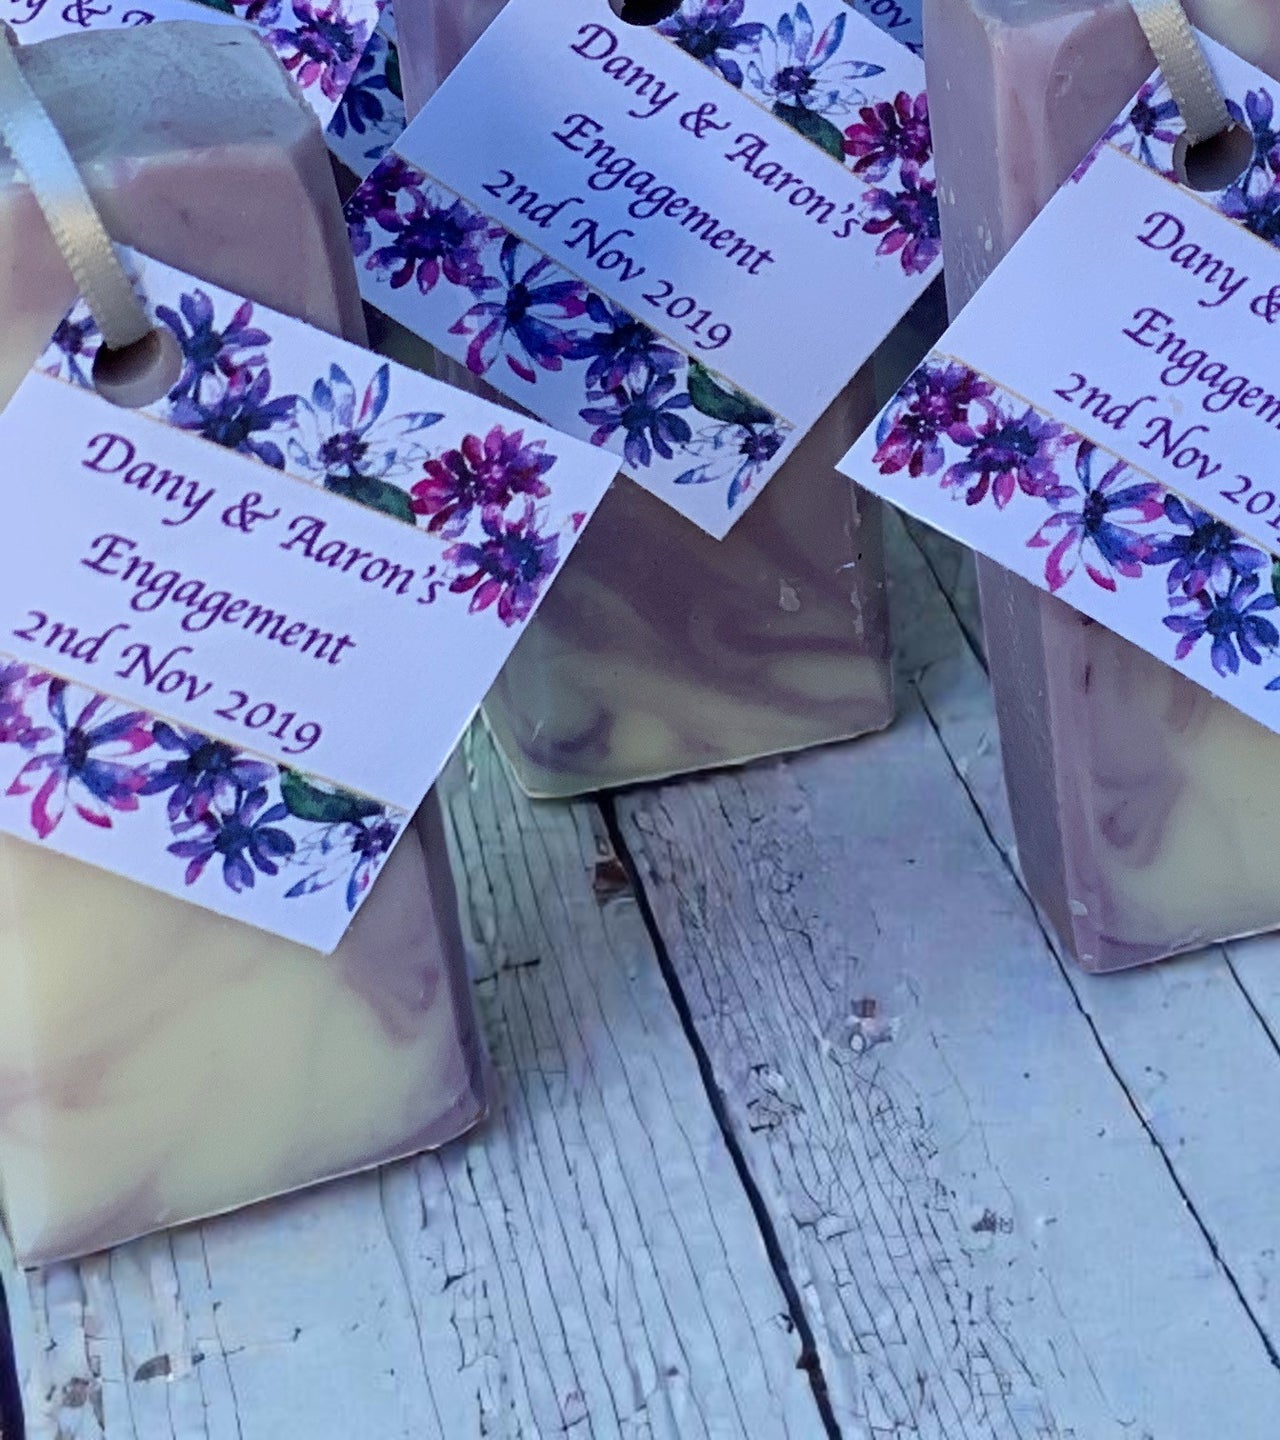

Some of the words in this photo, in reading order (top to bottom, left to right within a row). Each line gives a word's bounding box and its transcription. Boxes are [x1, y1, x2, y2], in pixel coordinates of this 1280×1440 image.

[552, 112, 776, 275] Engagement
[570, 22, 680, 119] Dany
[679, 103, 731, 139] &
[725, 133, 863, 240] Aaron's
[482, 170, 572, 227] 2nd
[565, 217, 646, 283] Nov
[642, 278, 733, 349] 2019
[1137, 210, 1249, 308] Dany
[1054, 372, 1145, 432] 2nd
[1138, 416, 1222, 480] Nov
[82, 432, 214, 526] Dany
[221, 492, 281, 533] &
[280, 517, 447, 606] Aaron's
[81, 533, 356, 665] Engagement
[14, 611, 119, 663] 2nd
[116, 643, 212, 704] Nov
[215, 691, 323, 755] 2019
